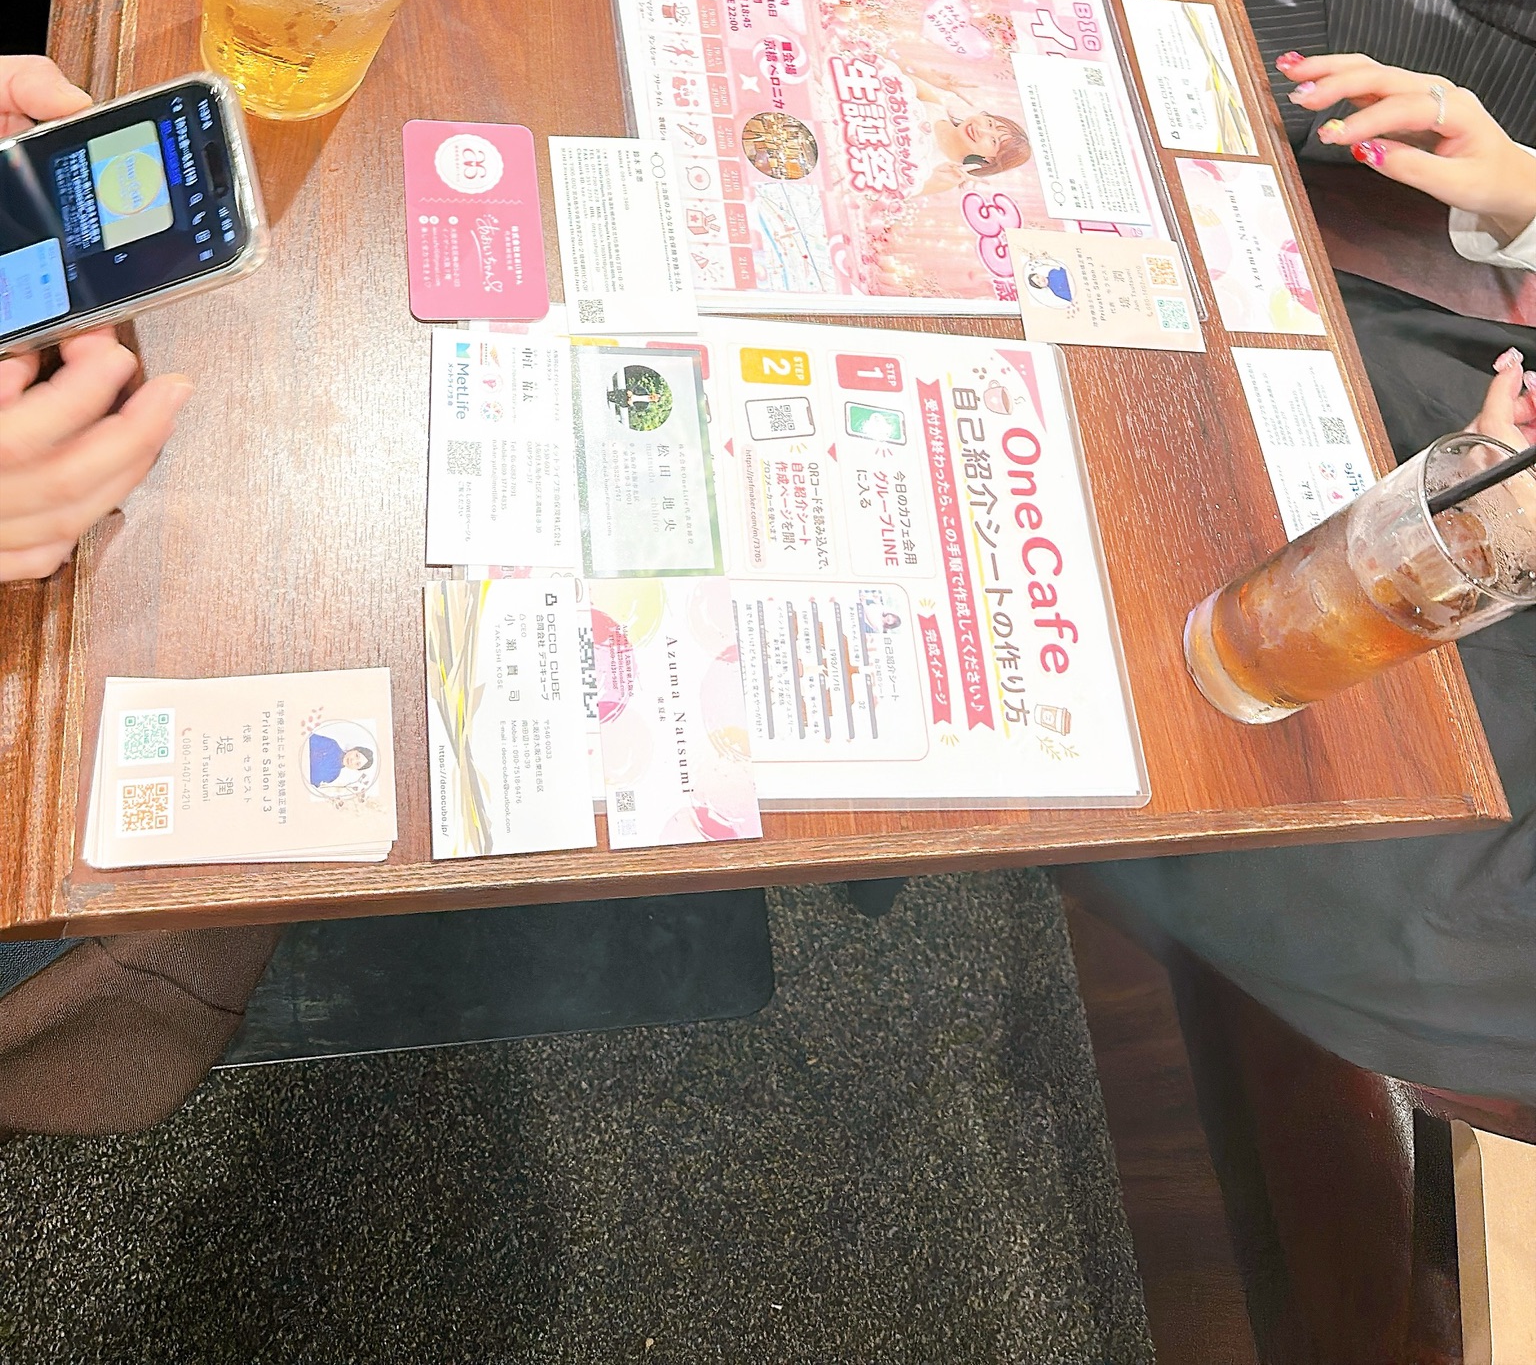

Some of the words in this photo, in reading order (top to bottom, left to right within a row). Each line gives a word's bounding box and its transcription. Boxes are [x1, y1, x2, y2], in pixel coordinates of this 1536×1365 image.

[727, 6, 739, 32] 22:00
[740, 3, 752, 29] 18:45
[1073, 2, 1102, 52] BIG
[763, 39, 777, 62] 京橋
[828, 55, 899, 195] 生誕祭
[881, 76, 919, 178] あおいちゃん
[1224, 189, 1249, 241] Natsumi
[1089, 269, 1100, 290] Salon
[1246, 248, 1265, 291] Azuma
[1095, 292, 1107, 322] Private
[522, 347, 533, 368] 中江
[762, 357, 790, 376] 2
[793, 356, 805, 380] STEP
[856, 366, 884, 378] 1
[885, 362, 897, 387] STEP
[456, 363, 471, 420] MetLife
[553, 443, 562, 547] メットライフ生命保険株式会社
[763, 460, 777, 542] プロフメーカーを使います
[791, 462, 811, 546] 自己紹介シート
[856, 469, 872, 509] に入る
[1342, 462, 1361, 501] etLife
[774, 461, 797, 552] 作成ページを開く
[808, 462, 829, 570] QRコードを読み込んで、
[873, 470, 899, 567] グループLINE
[893, 471, 918, 565] 今日のカフェ会用
[923, 398, 978, 701] 受付が終わったら、この手順で作成してください
[951, 387, 1030, 727] 自己紹介シートの作り方
[1000, 427, 1079, 675] OneCafe
[494, 624, 502, 663] TAKASHI
[536, 614, 547, 648] 合同会社
[546, 613, 558, 654] DECO
[495, 666, 504, 690] KOSE
[538, 651, 550, 701] デコキューブ
[549, 661, 561, 701] CUBE
[829, 648, 841, 692] 1993/11/16
[883, 637, 900, 702] 自己紹介シート
[924, 629, 948, 705] 完成イメージ
[665, 636, 680, 699] Azuma
[673, 712, 694, 794] Natsumi
[858, 700, 866, 710] 32
[201, 732, 211, 751] Jun
[242, 724, 252, 743] 代表
[261, 711, 271, 753] Private
[181, 738, 191, 811] 080-1407-4210
[201, 755, 211, 802] Tsutsumi
[242, 754, 252, 804] セラピスト
[262, 758, 272, 791] Salon
[276, 700, 287, 825] 理学療法士による姿勢矯正専門
[437, 744, 450, 837] https://decocube.jp/
